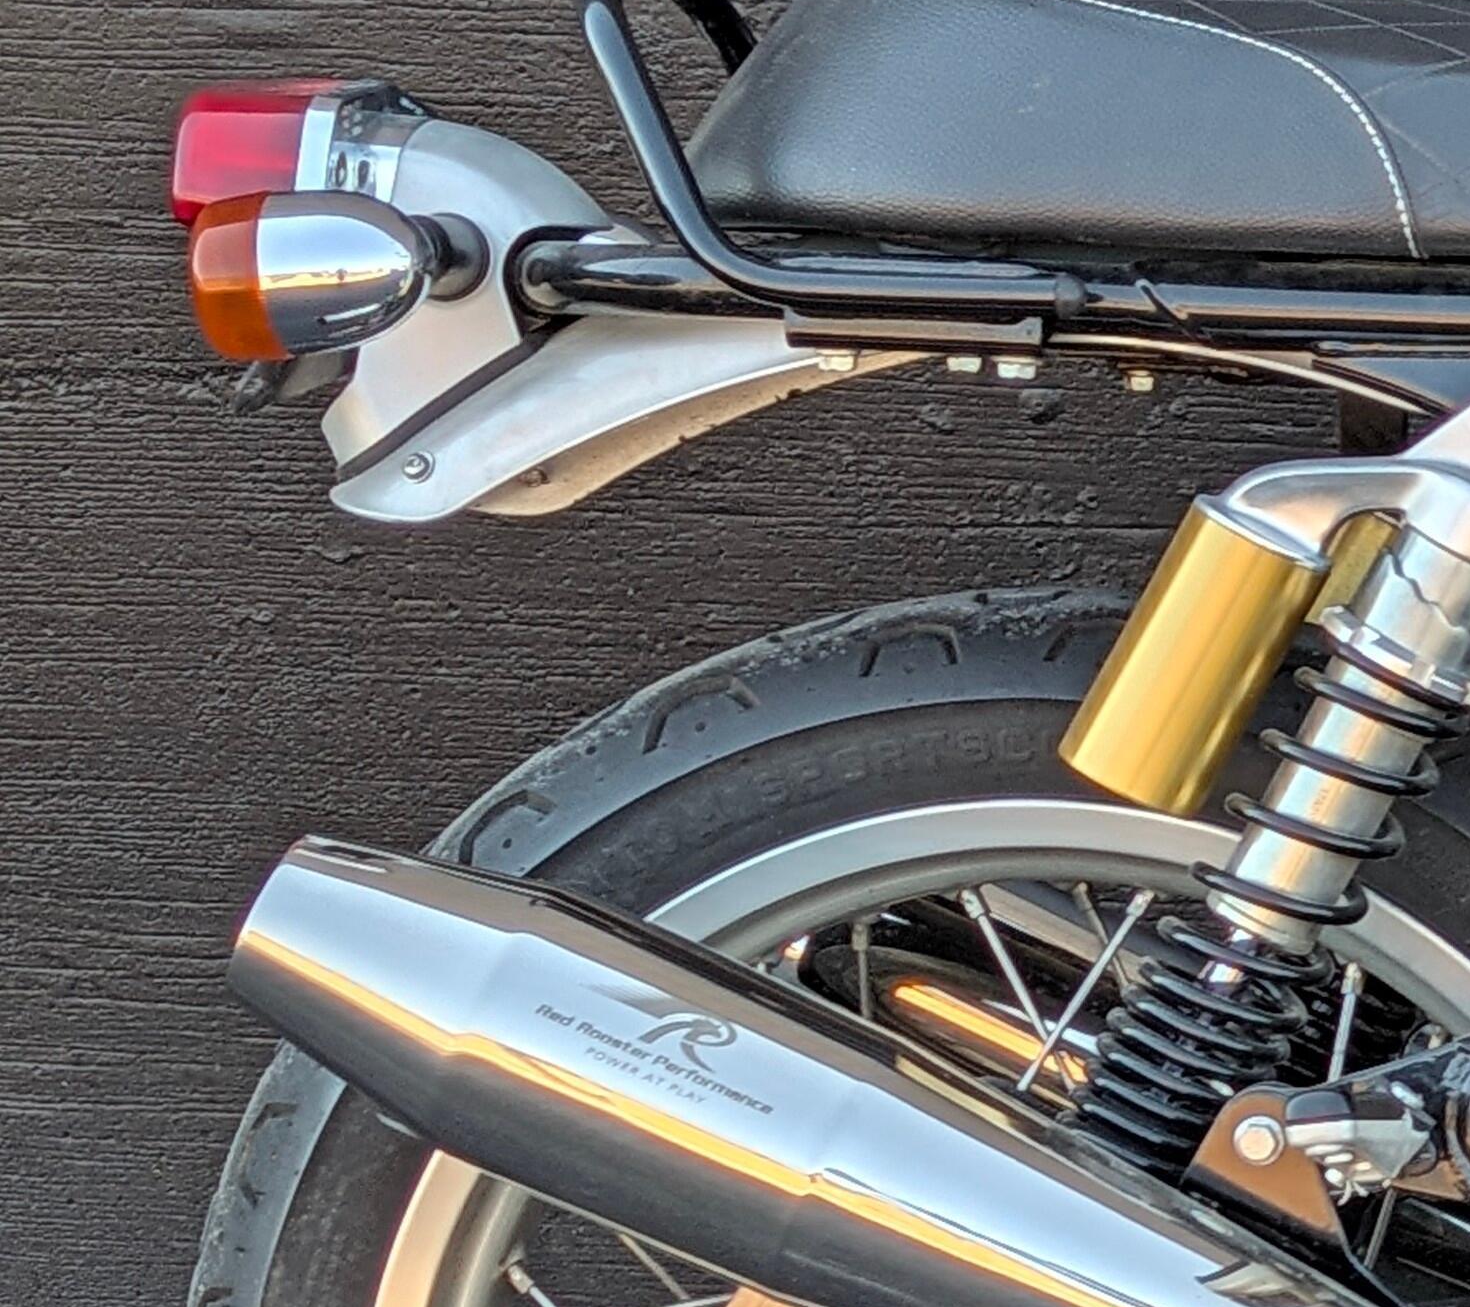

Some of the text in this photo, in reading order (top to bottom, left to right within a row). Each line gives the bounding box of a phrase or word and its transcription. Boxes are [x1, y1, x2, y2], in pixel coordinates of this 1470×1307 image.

[534, 1002, 776, 1116] Red Rooster Performance
